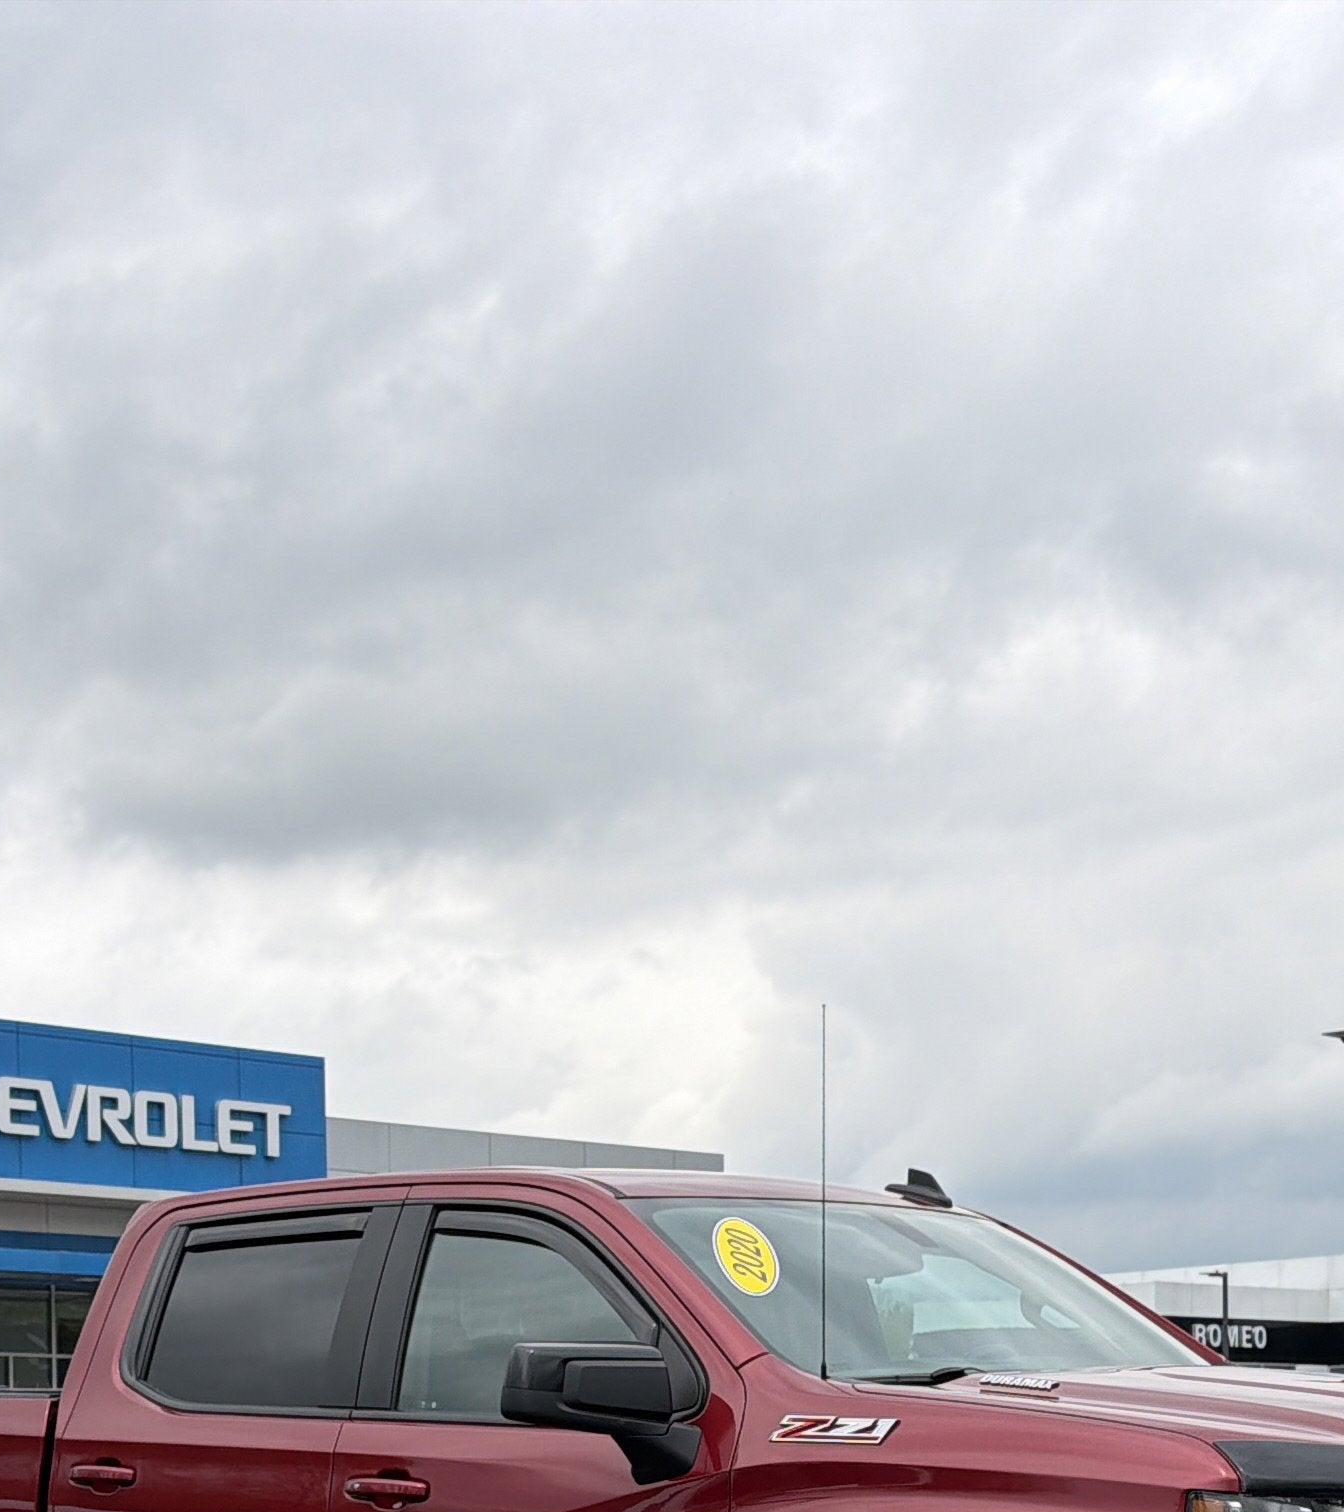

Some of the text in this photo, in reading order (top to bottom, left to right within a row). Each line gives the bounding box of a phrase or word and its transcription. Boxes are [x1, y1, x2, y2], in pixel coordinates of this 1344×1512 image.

[724, 1228, 769, 1284] 2020
[1192, 1323, 1267, 1349] ROMEO
[979, 1374, 1060, 1392] DURAMAX
[769, 1414, 900, 1445] Z71
